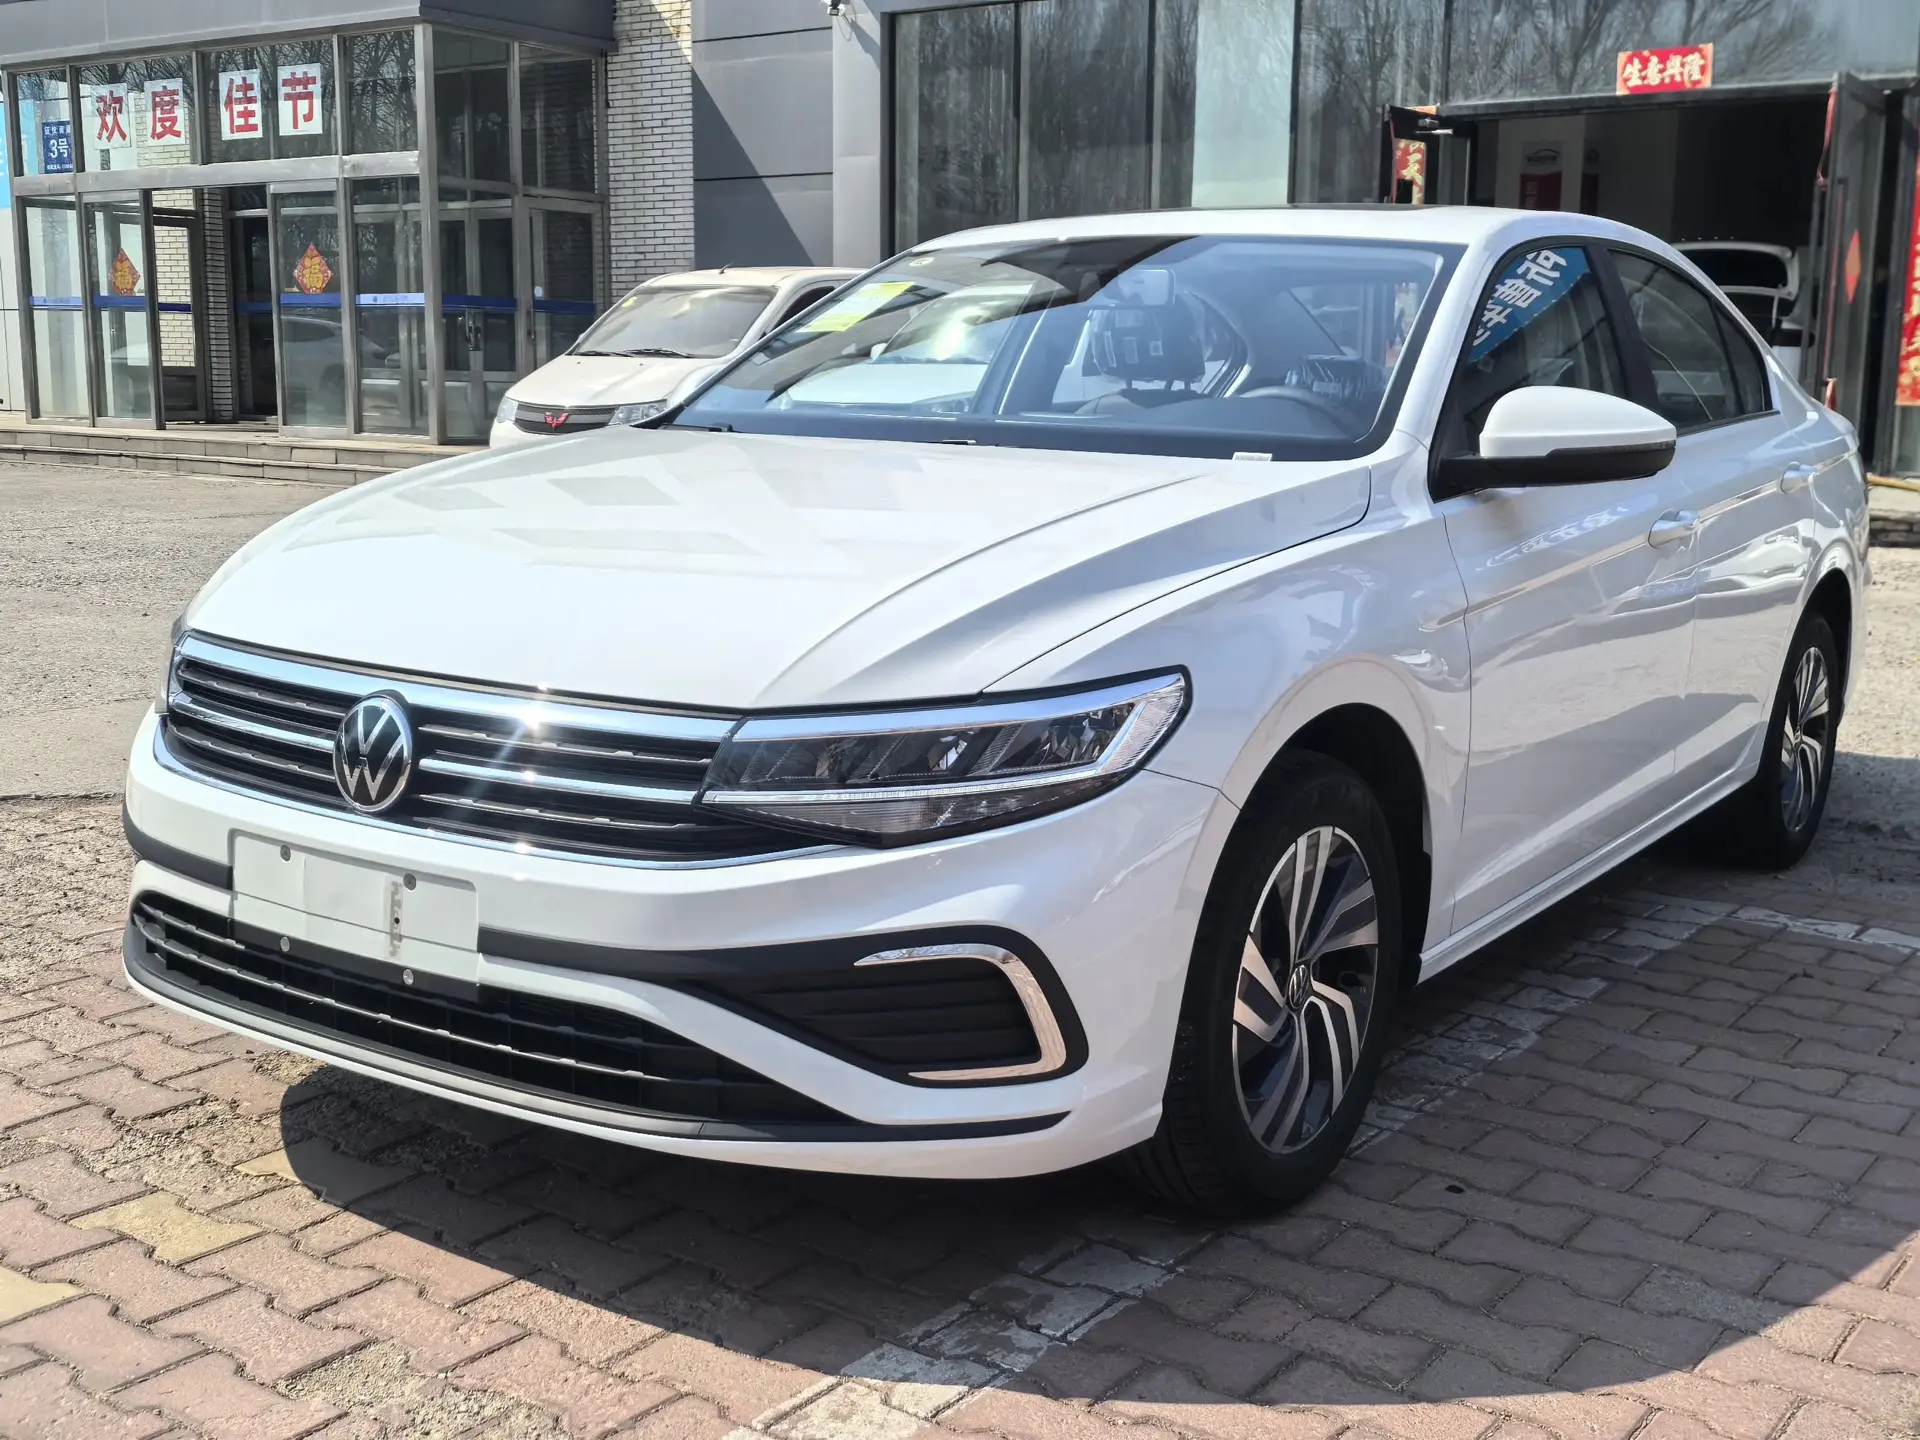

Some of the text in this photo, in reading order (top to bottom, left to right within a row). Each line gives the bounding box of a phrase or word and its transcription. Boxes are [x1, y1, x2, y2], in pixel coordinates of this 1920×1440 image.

[96, 70, 317, 143] 欢度佳节
[49, 137, 70, 159] 3号
